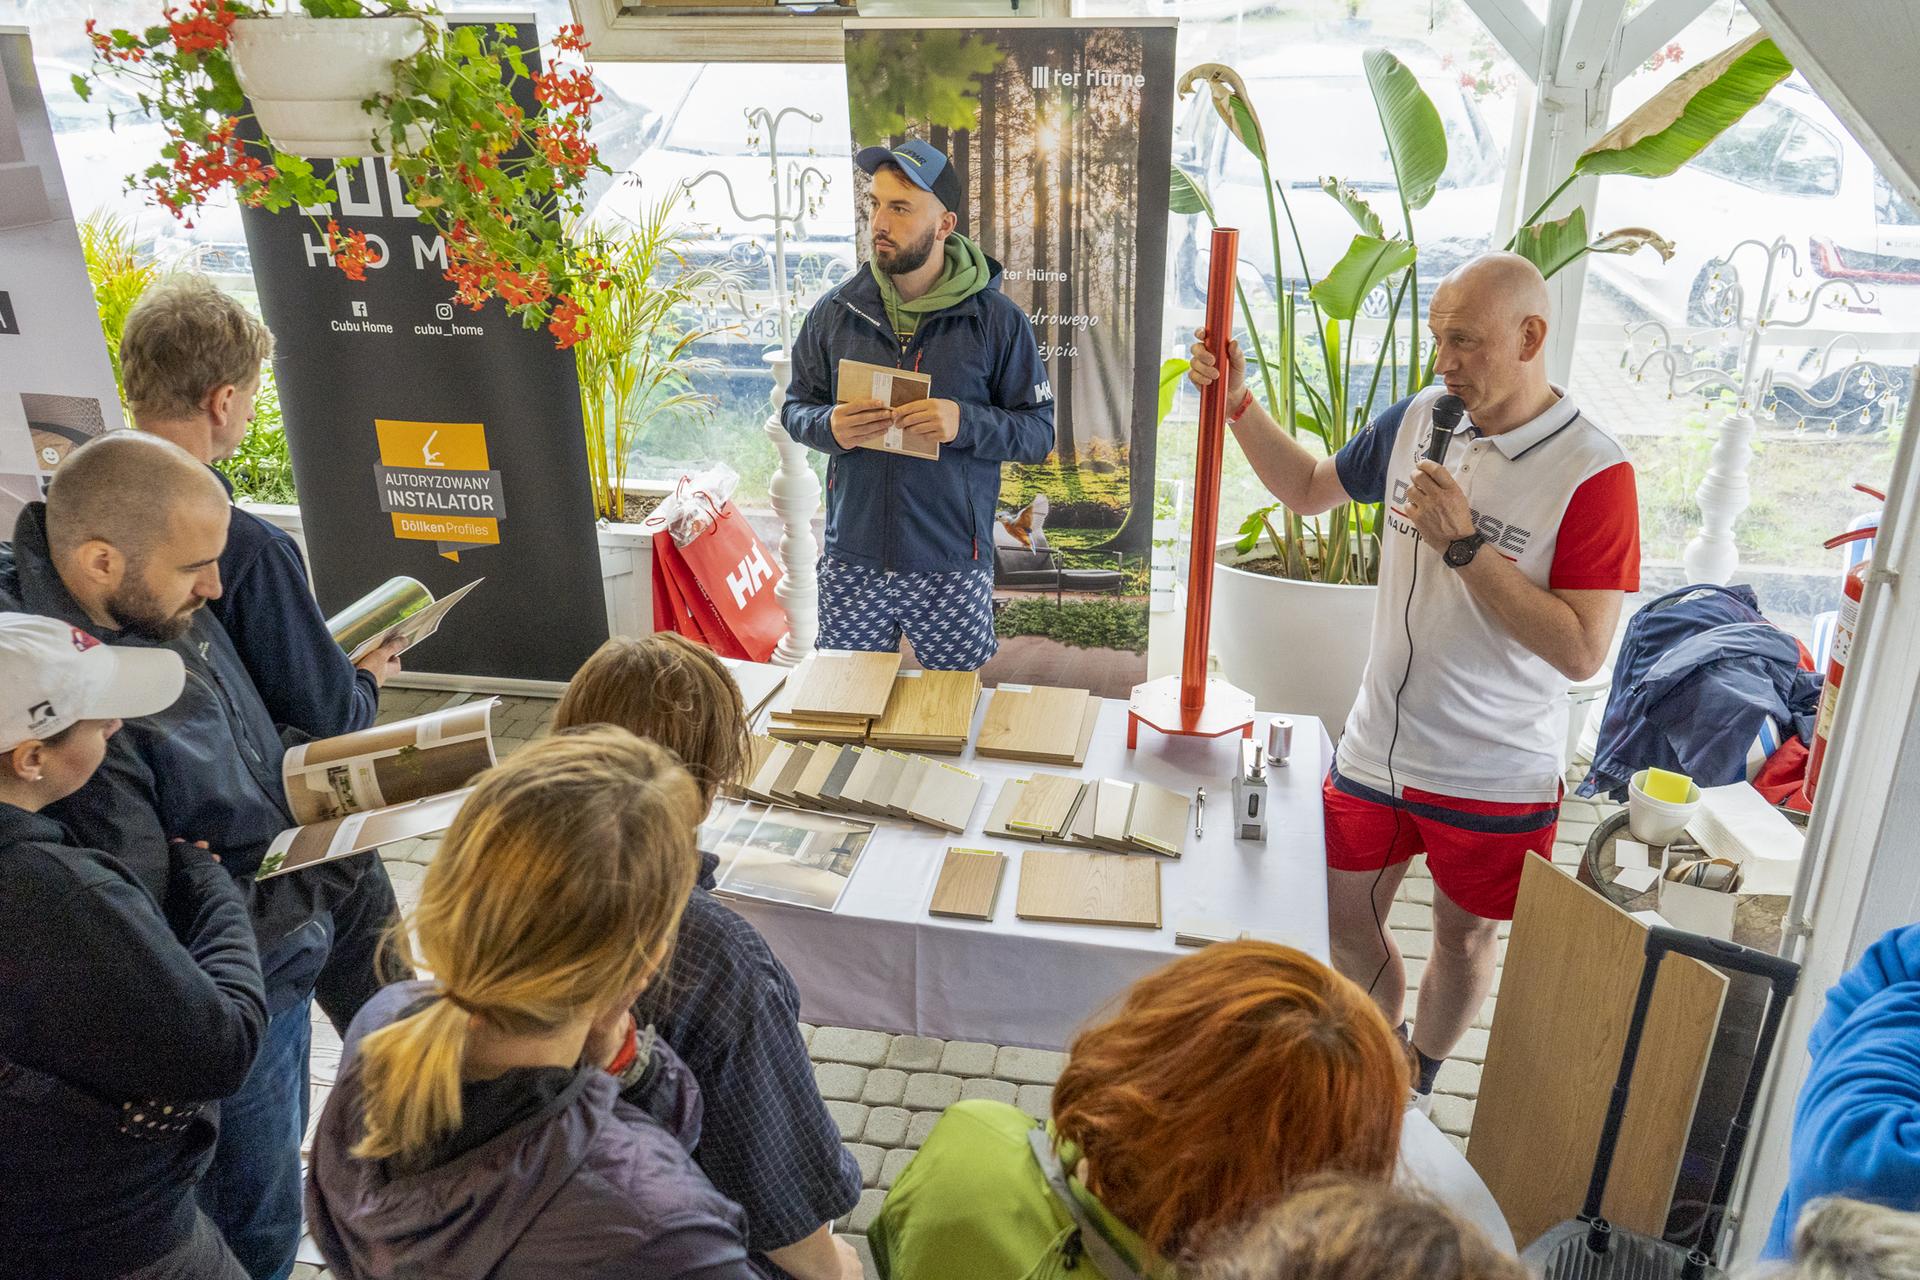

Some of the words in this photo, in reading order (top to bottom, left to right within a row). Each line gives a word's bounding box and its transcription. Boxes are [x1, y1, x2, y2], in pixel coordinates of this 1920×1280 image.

[1053, 69, 1081, 87] ter
[1003, 269, 1022, 280] ter
[1026, 269, 1067, 282] Hürne
[331, 320, 360, 332] Cubu
[362, 320, 393, 333] Home
[1025, 307, 1098, 332] drowego
[414, 323, 484, 336] cubu_home
[1037, 341, 1079, 361] życia
[385, 473, 490, 490] AUTORYZOWANY
[387, 490, 494, 511] INSTALATOR
[401, 519, 446, 533] Döllken
[446, 522, 489, 536] Profiles
[1387, 514, 1422, 542] NAUT
[725, 538, 774, 611] HH
